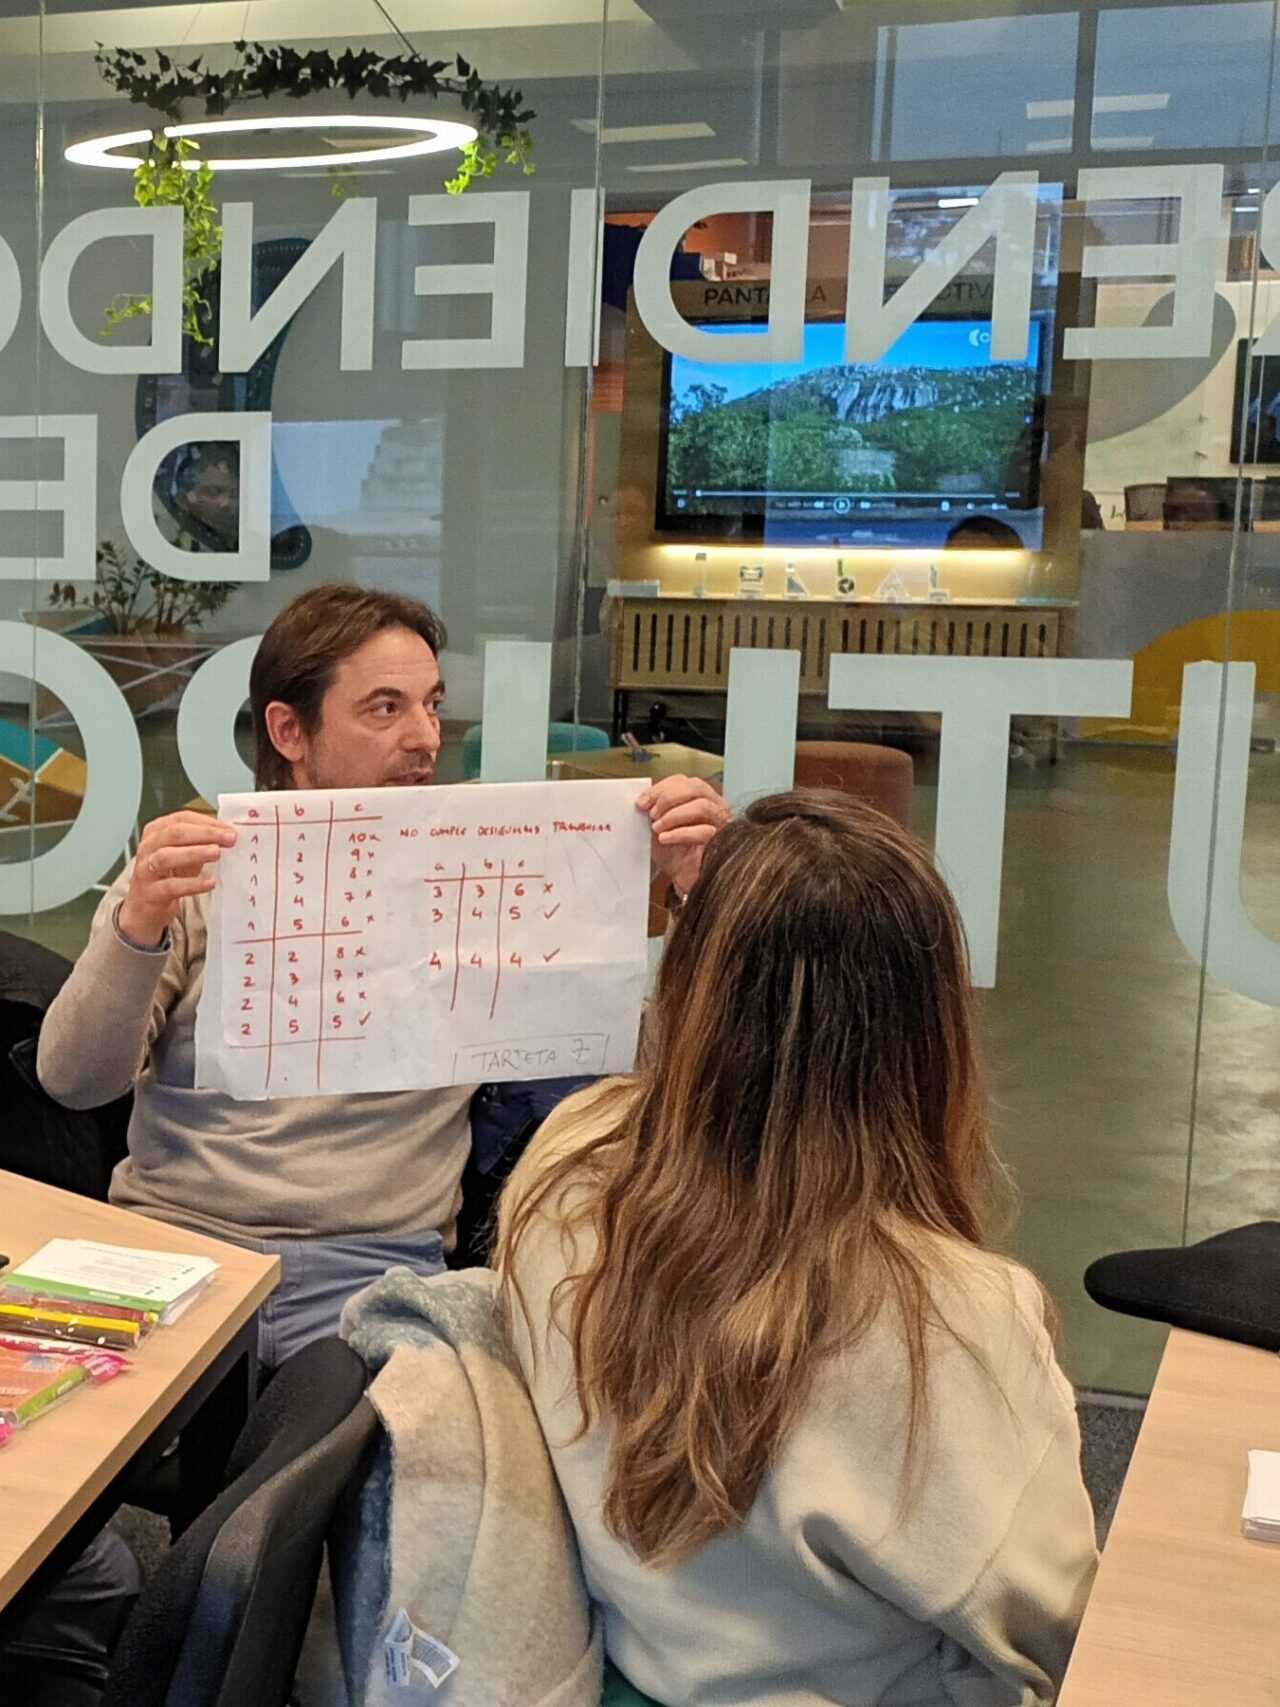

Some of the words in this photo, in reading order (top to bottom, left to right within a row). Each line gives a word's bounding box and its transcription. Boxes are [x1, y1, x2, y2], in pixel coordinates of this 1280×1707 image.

[704, 285, 827, 306] PANTA
[398, 827, 419, 839] NO
[472, 1049, 557, 1072] TARJETA
